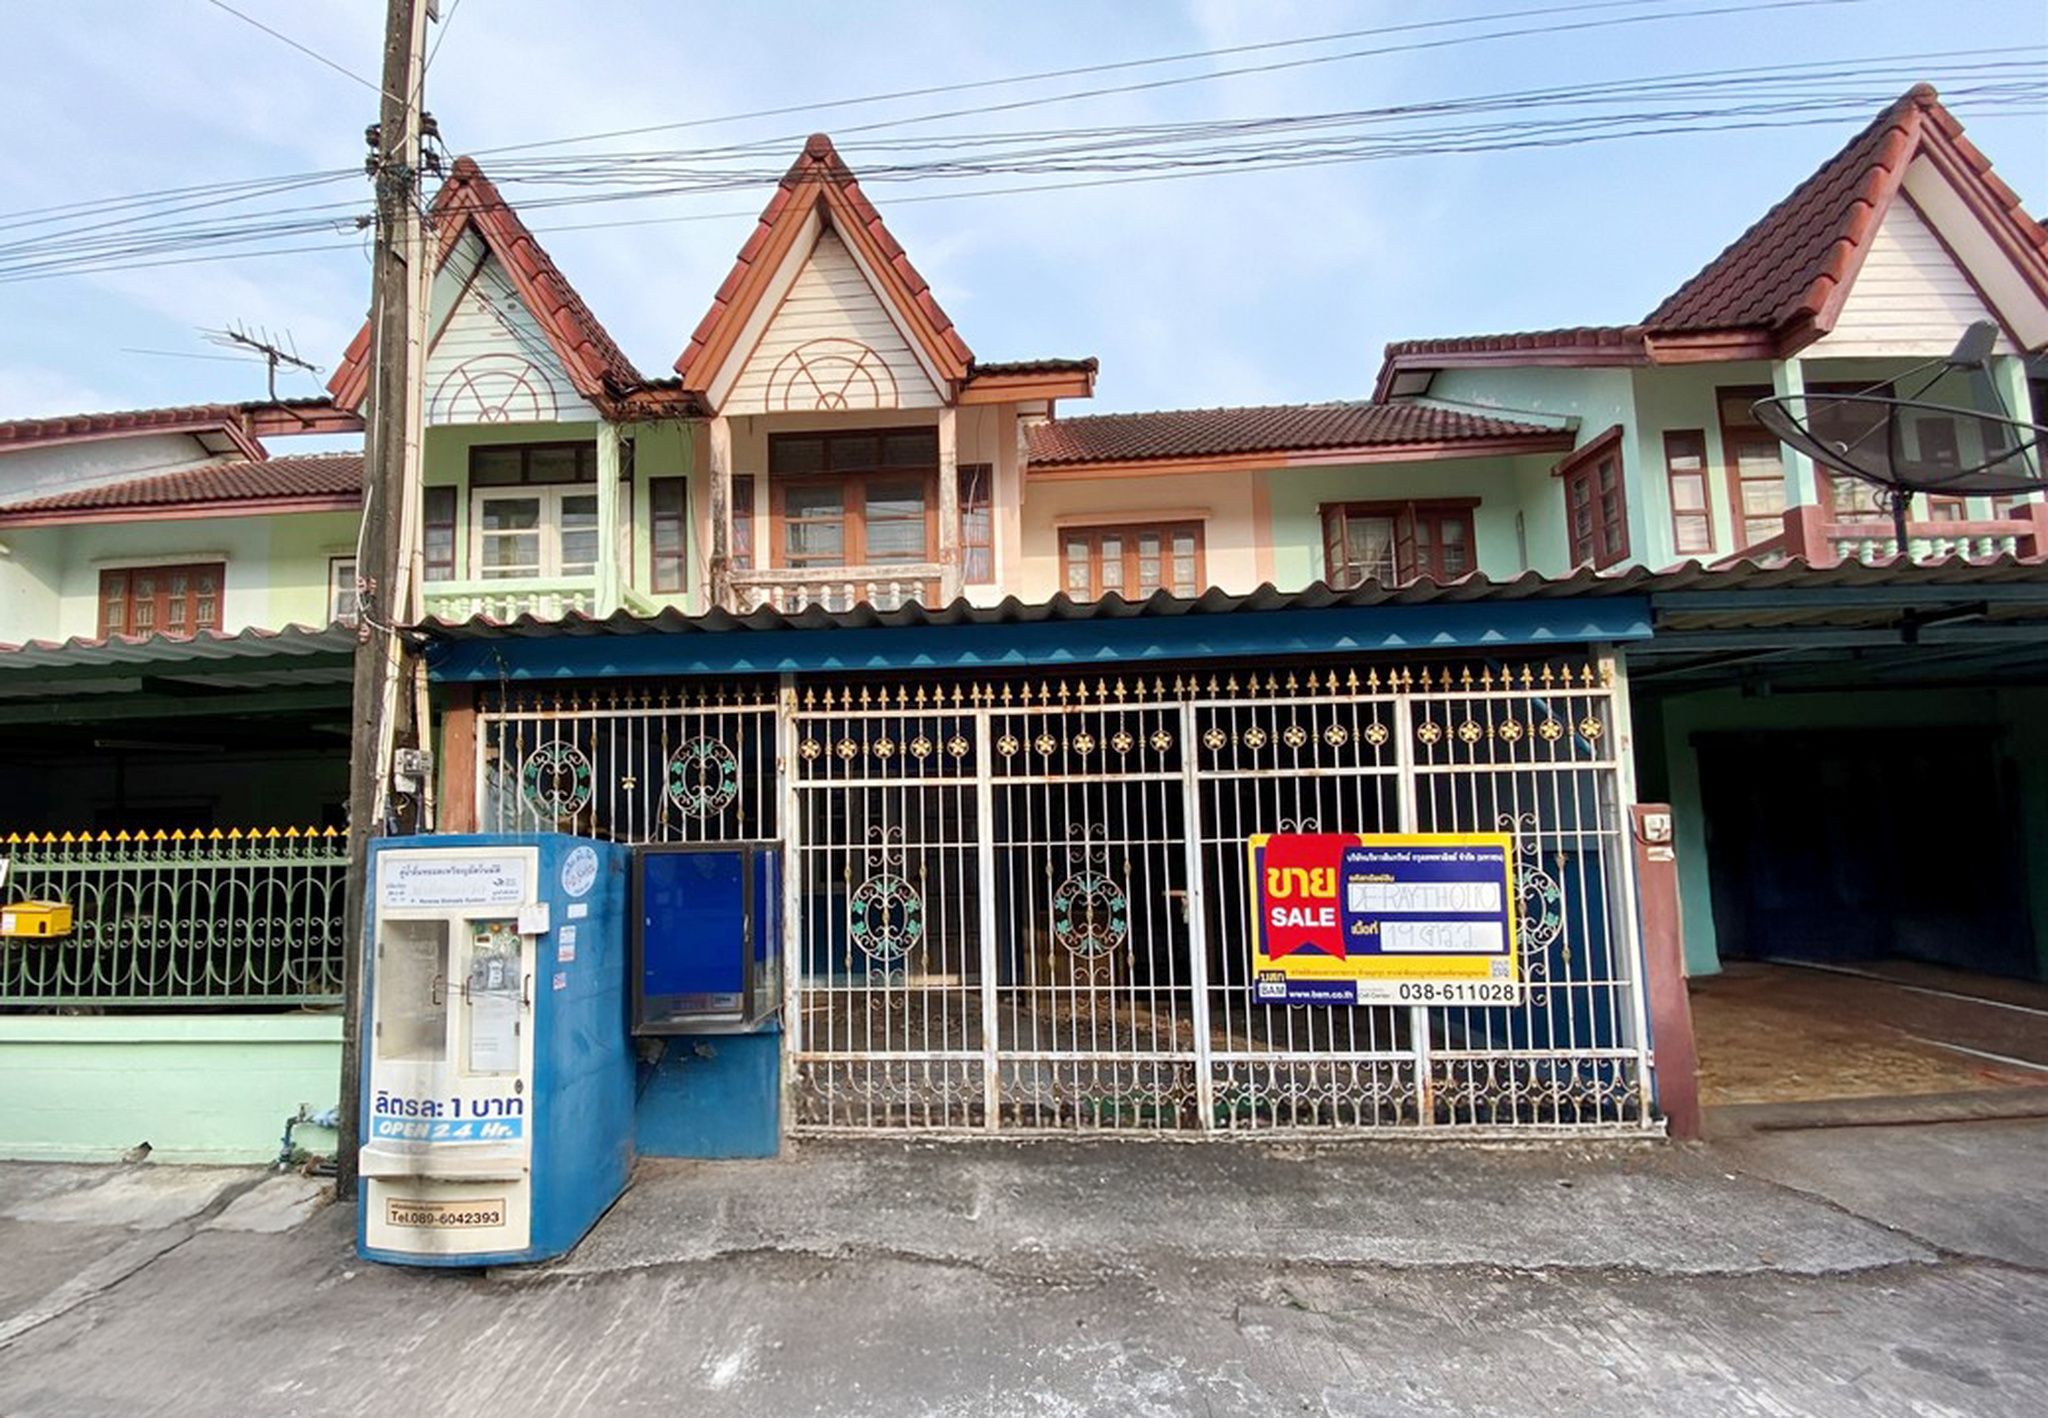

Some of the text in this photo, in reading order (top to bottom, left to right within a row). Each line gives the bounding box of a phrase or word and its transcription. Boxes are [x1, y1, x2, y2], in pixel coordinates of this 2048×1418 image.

[1267, 867, 1336, 898] ขาย
[1271, 907, 1336, 927] SALE
[1261, 984, 1285, 996] BAM
[1289, 990, 1354, 999] www.bam.co.th
[1399, 983, 1514, 1001] 038-611028
[376, 1090, 523, 1117] ลิตรละ 1 บาท
[379, 1121, 430, 1138] OPEN
[480, 1122, 513, 1137] Hr.
